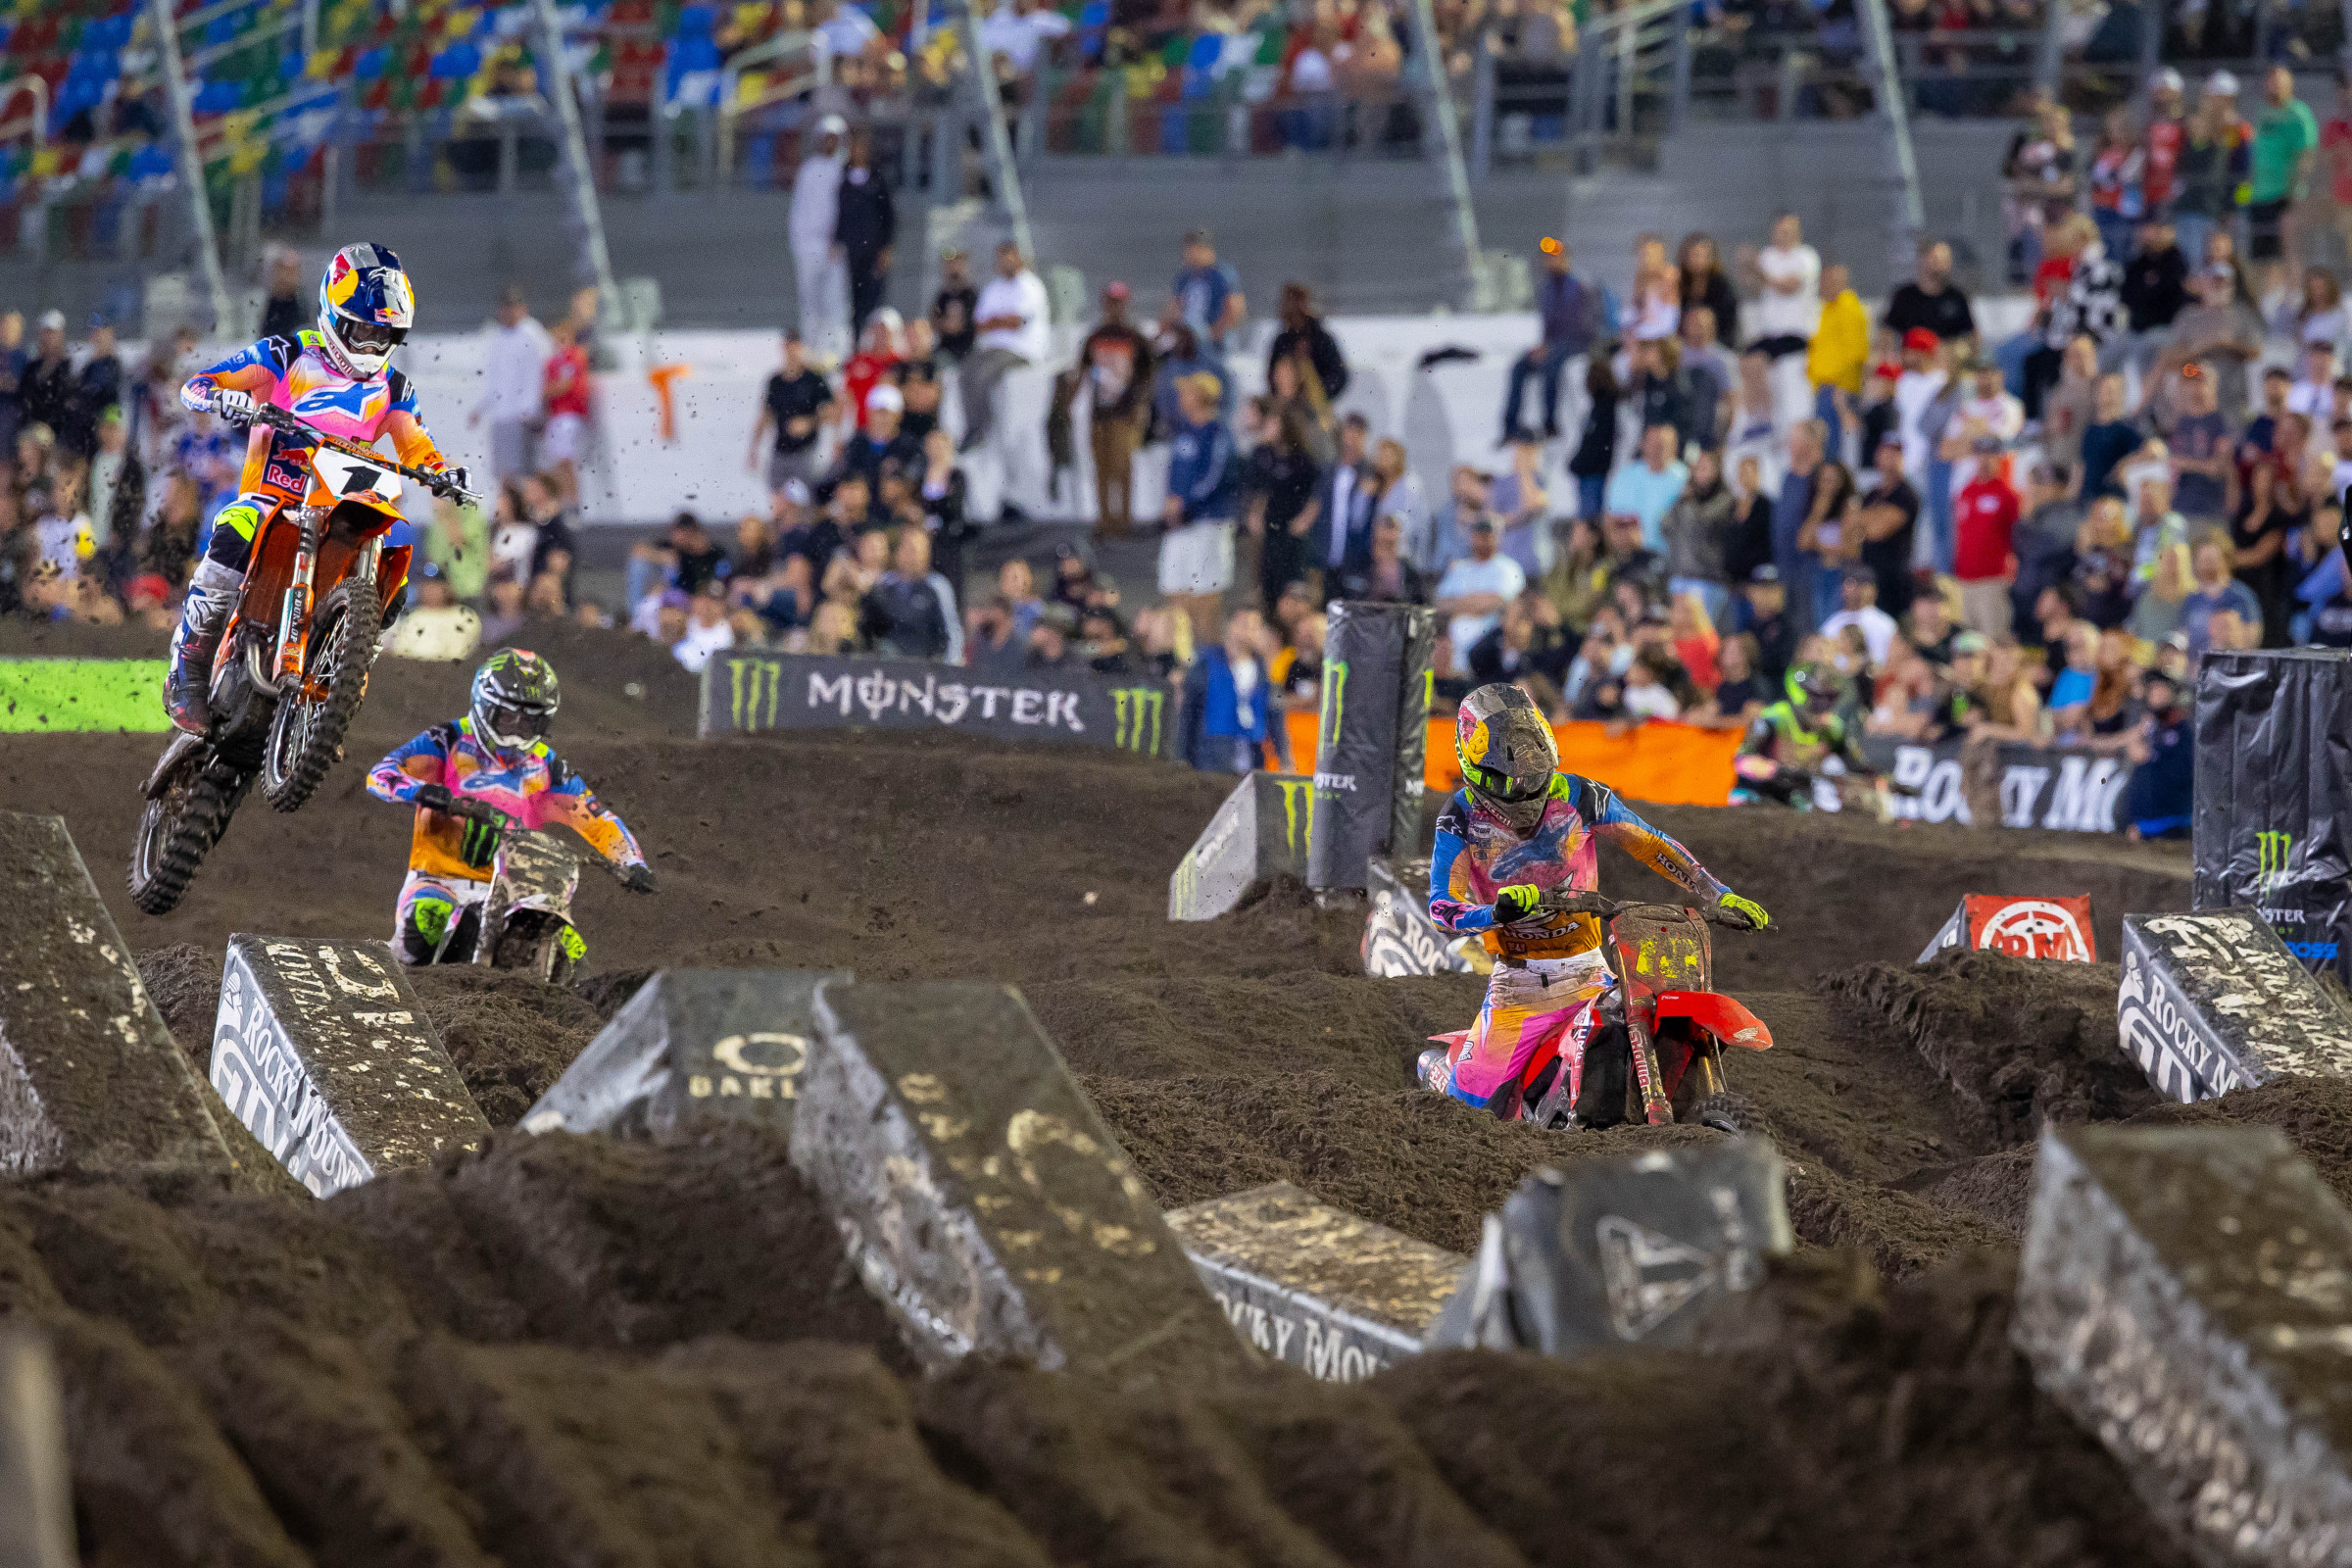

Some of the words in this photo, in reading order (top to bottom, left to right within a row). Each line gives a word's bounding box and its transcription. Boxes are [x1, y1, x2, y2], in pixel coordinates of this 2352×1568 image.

[267, 464, 308, 493] Red
[341, 466, 382, 495] 1
[290, 598, 303, 643] DUNLOP
[807, 668, 1085, 732] MONSTER
[1503, 921, 1581, 940] HONDA
[2146, 975, 2212, 1075] ROCKY
[243, 997, 306, 1113] ROCKY
